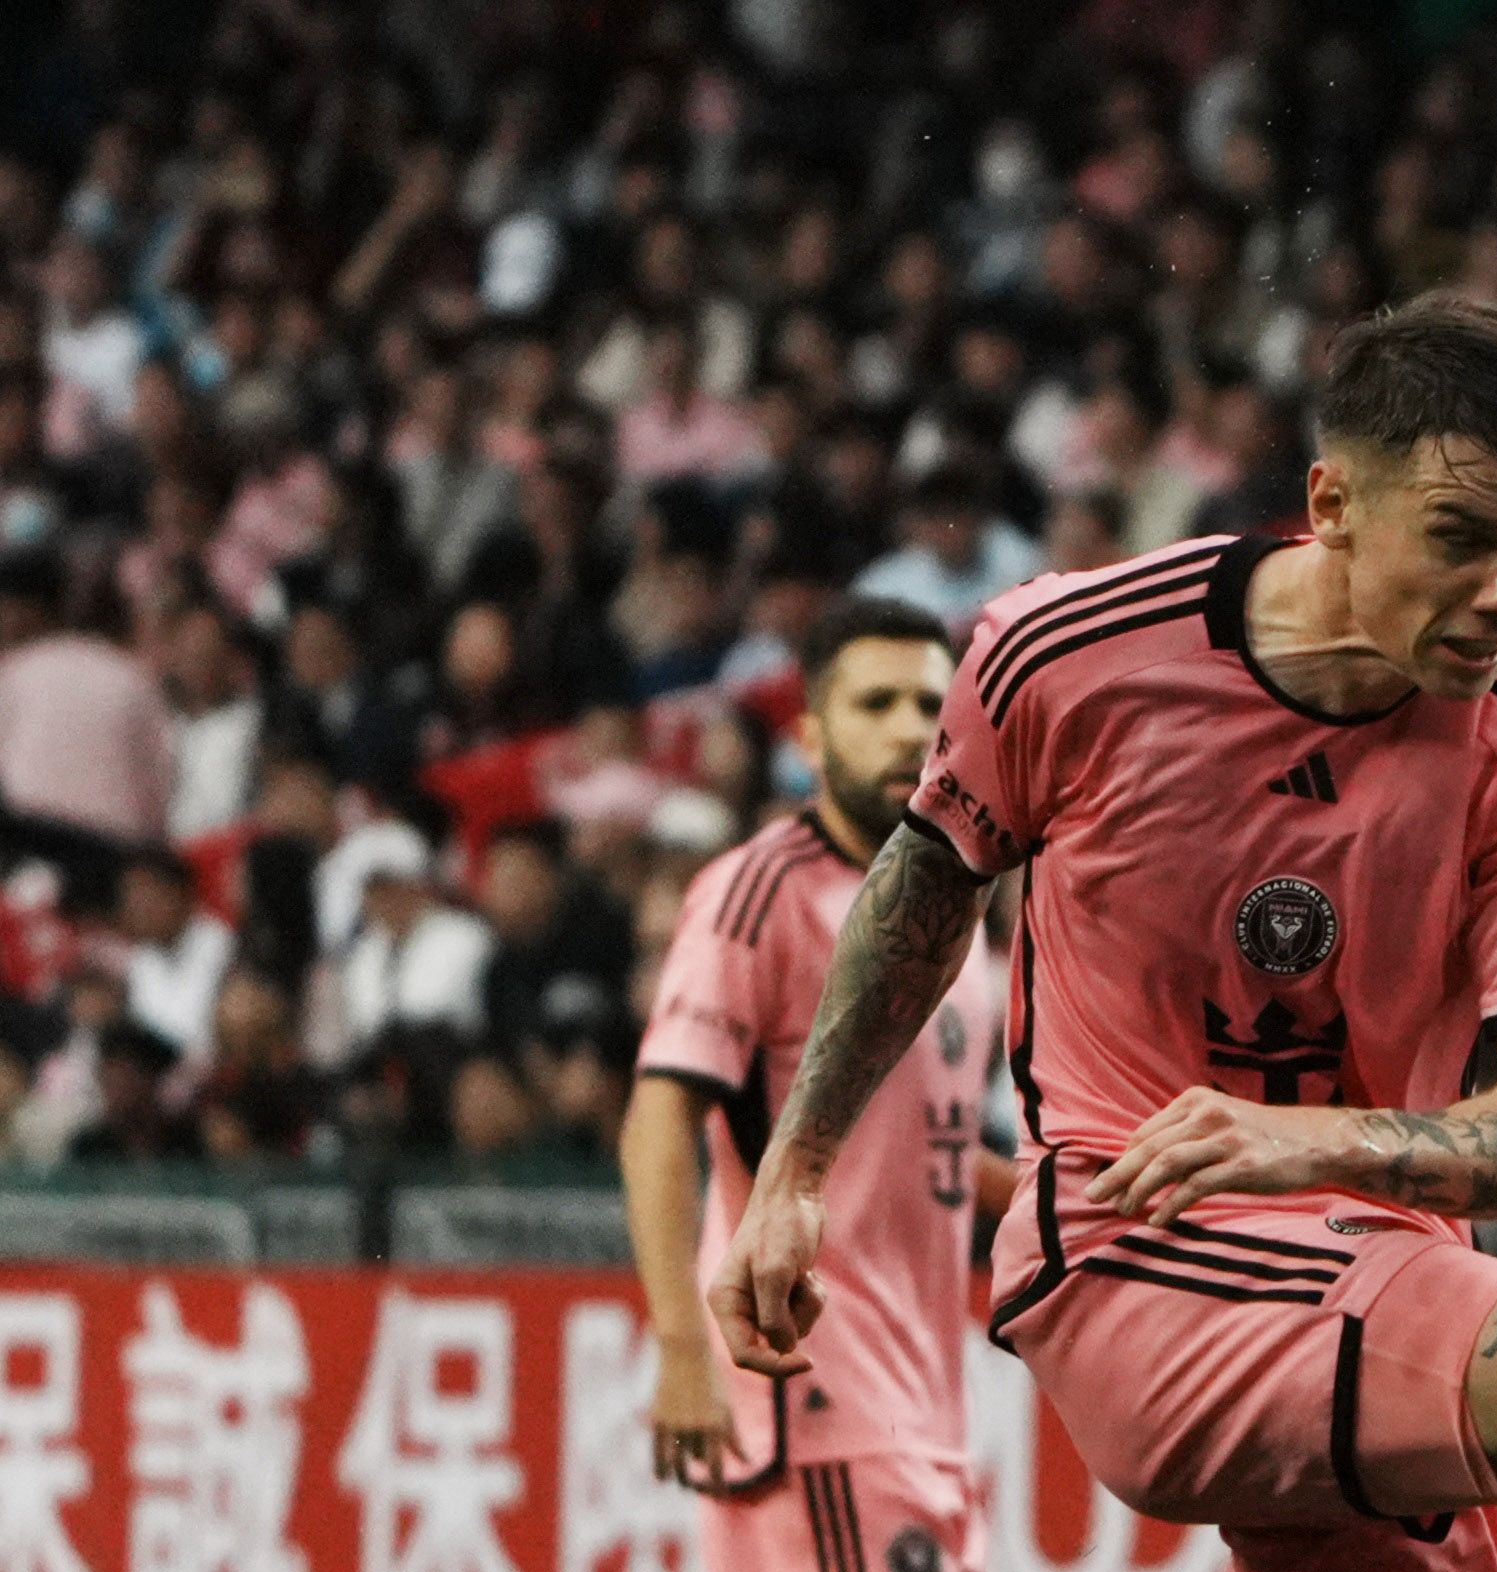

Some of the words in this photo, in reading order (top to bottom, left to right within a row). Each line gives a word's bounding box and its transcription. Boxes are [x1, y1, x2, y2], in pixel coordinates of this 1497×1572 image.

[1240, 880, 1321, 918] INTERNACIONAL
[1268, 903, 1308, 915] MIAMI
[1238, 922, 1250, 951] CLUB
[1265, 962, 1297, 973] MMXX
